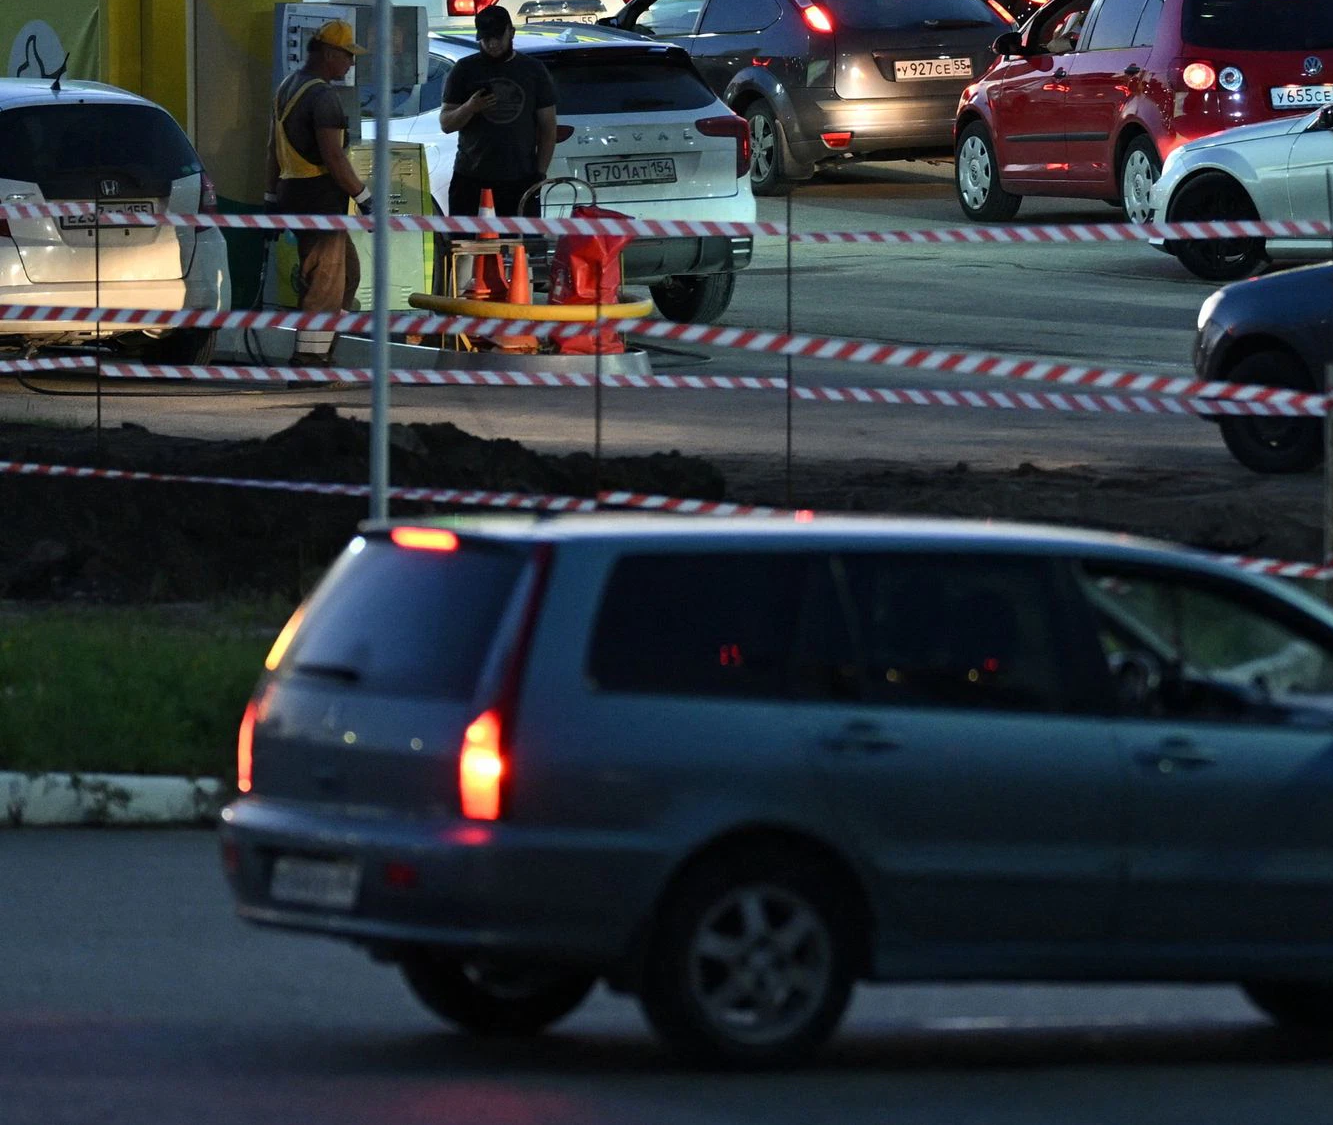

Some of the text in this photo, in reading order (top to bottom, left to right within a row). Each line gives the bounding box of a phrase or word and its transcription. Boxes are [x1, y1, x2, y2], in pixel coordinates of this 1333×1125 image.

[901, 60, 966, 75] У927СЕ 55
[1277, 88, 1331, 104] У655СЕ
[577, 130, 693, 145] HAVAL
[593, 161, 672, 181] Р701АТ 154
